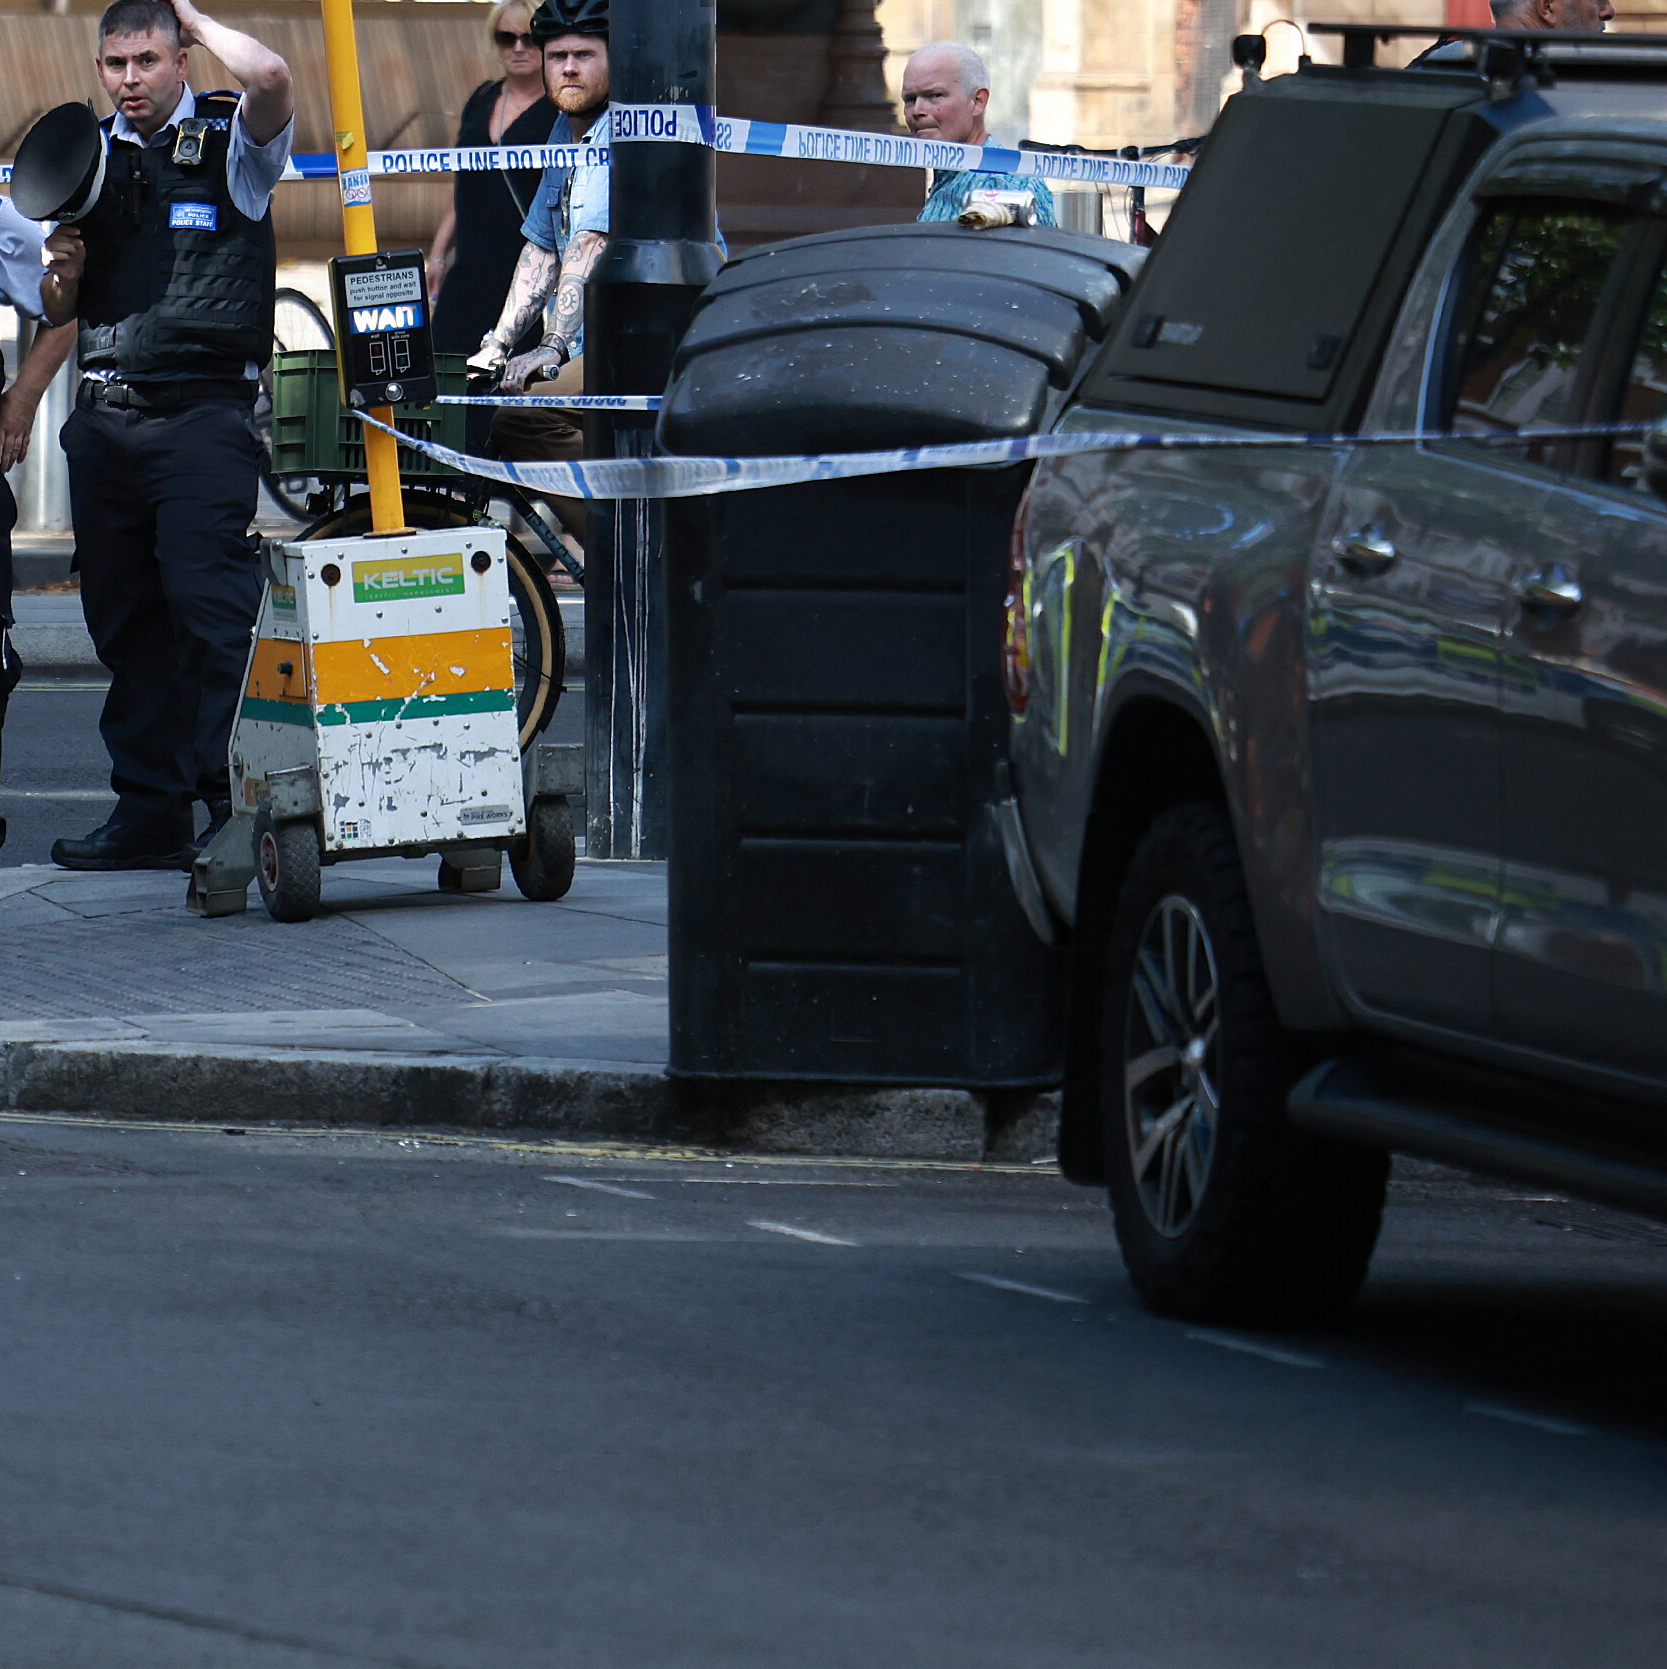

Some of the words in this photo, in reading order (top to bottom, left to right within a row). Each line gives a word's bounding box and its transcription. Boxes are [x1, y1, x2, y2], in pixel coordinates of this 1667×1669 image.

[614, 109, 677, 137] POLICE
[382, 153, 451, 173] POLICE
[456, 151, 502, 171] LINE
[506, 149, 530, 170] DO
[539, 148, 581, 169] NOT
[195, 220, 214, 228] STAFF
[349, 287, 366, 295] push
[367, 284, 388, 293] button
[403, 280, 417, 288] wait
[350, 271, 414, 285] PEDESTRIANS
[365, 292, 385, 302] signal
[385, 289, 414, 299] opposite
[352, 305, 417, 333] WAIT
[363, 567, 455, 591] KELTIC
